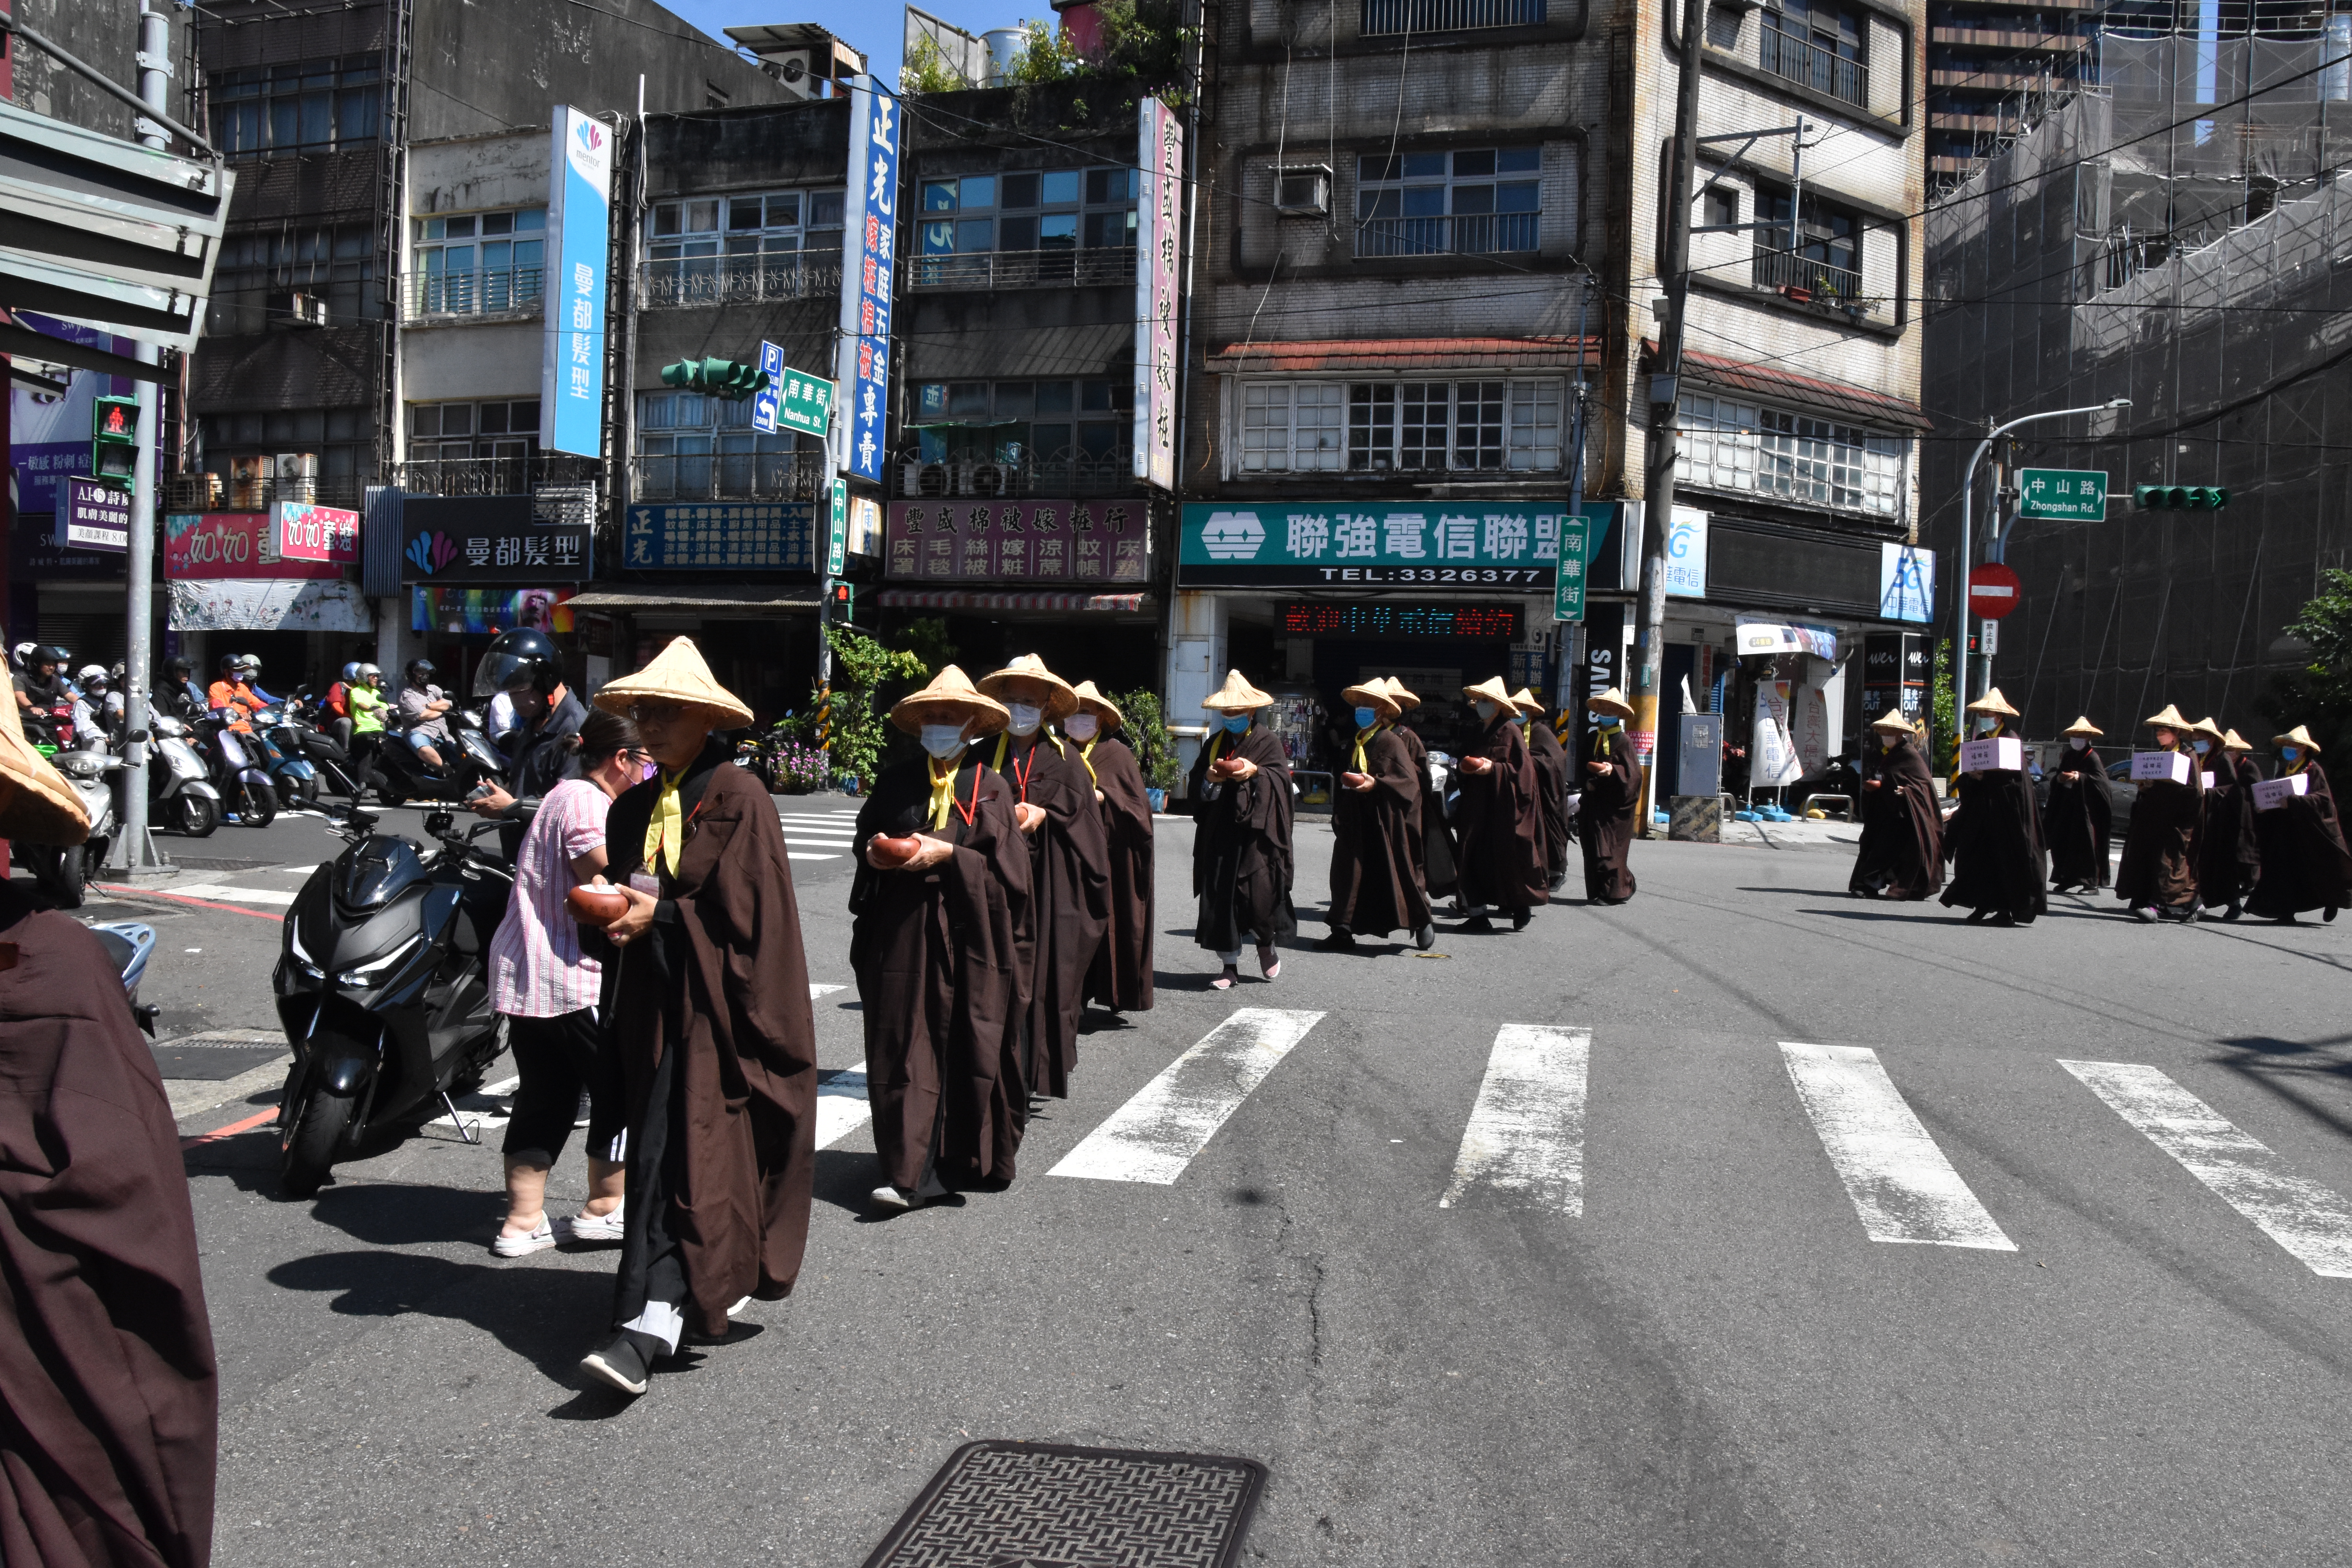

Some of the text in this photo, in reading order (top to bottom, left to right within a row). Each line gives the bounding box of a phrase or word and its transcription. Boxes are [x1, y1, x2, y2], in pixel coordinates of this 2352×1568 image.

[577, 150, 600, 168] mentor
[571, 262, 593, 399] 曼都髮型
[767, 348, 776, 368] P
[788, 378, 826, 407] 南華街
[755, 416, 768, 426] 290M
[784, 407, 822, 428] Nanhua St.
[858, 384, 878, 474] 專賣
[2031, 477, 2095, 495] 中山路
[2031, 501, 2096, 513] Zhongshan Rd.
[631, 509, 653, 564] 正光
[832, 494, 843, 559] 中山路
[1286, 513, 1561, 559] 聯強電信聯盟
[190, 527, 314, 565] 如如童
[466, 535, 581, 566] 曼都髮型
[1320, 568, 1540, 582] TEL:3326377
[1561, 533, 1581, 604] 南華街
[1893, 557, 1922, 590] 5G
[1887, 594, 1929, 615] 中華電信
[1904, 701, 1918, 710] OUT
